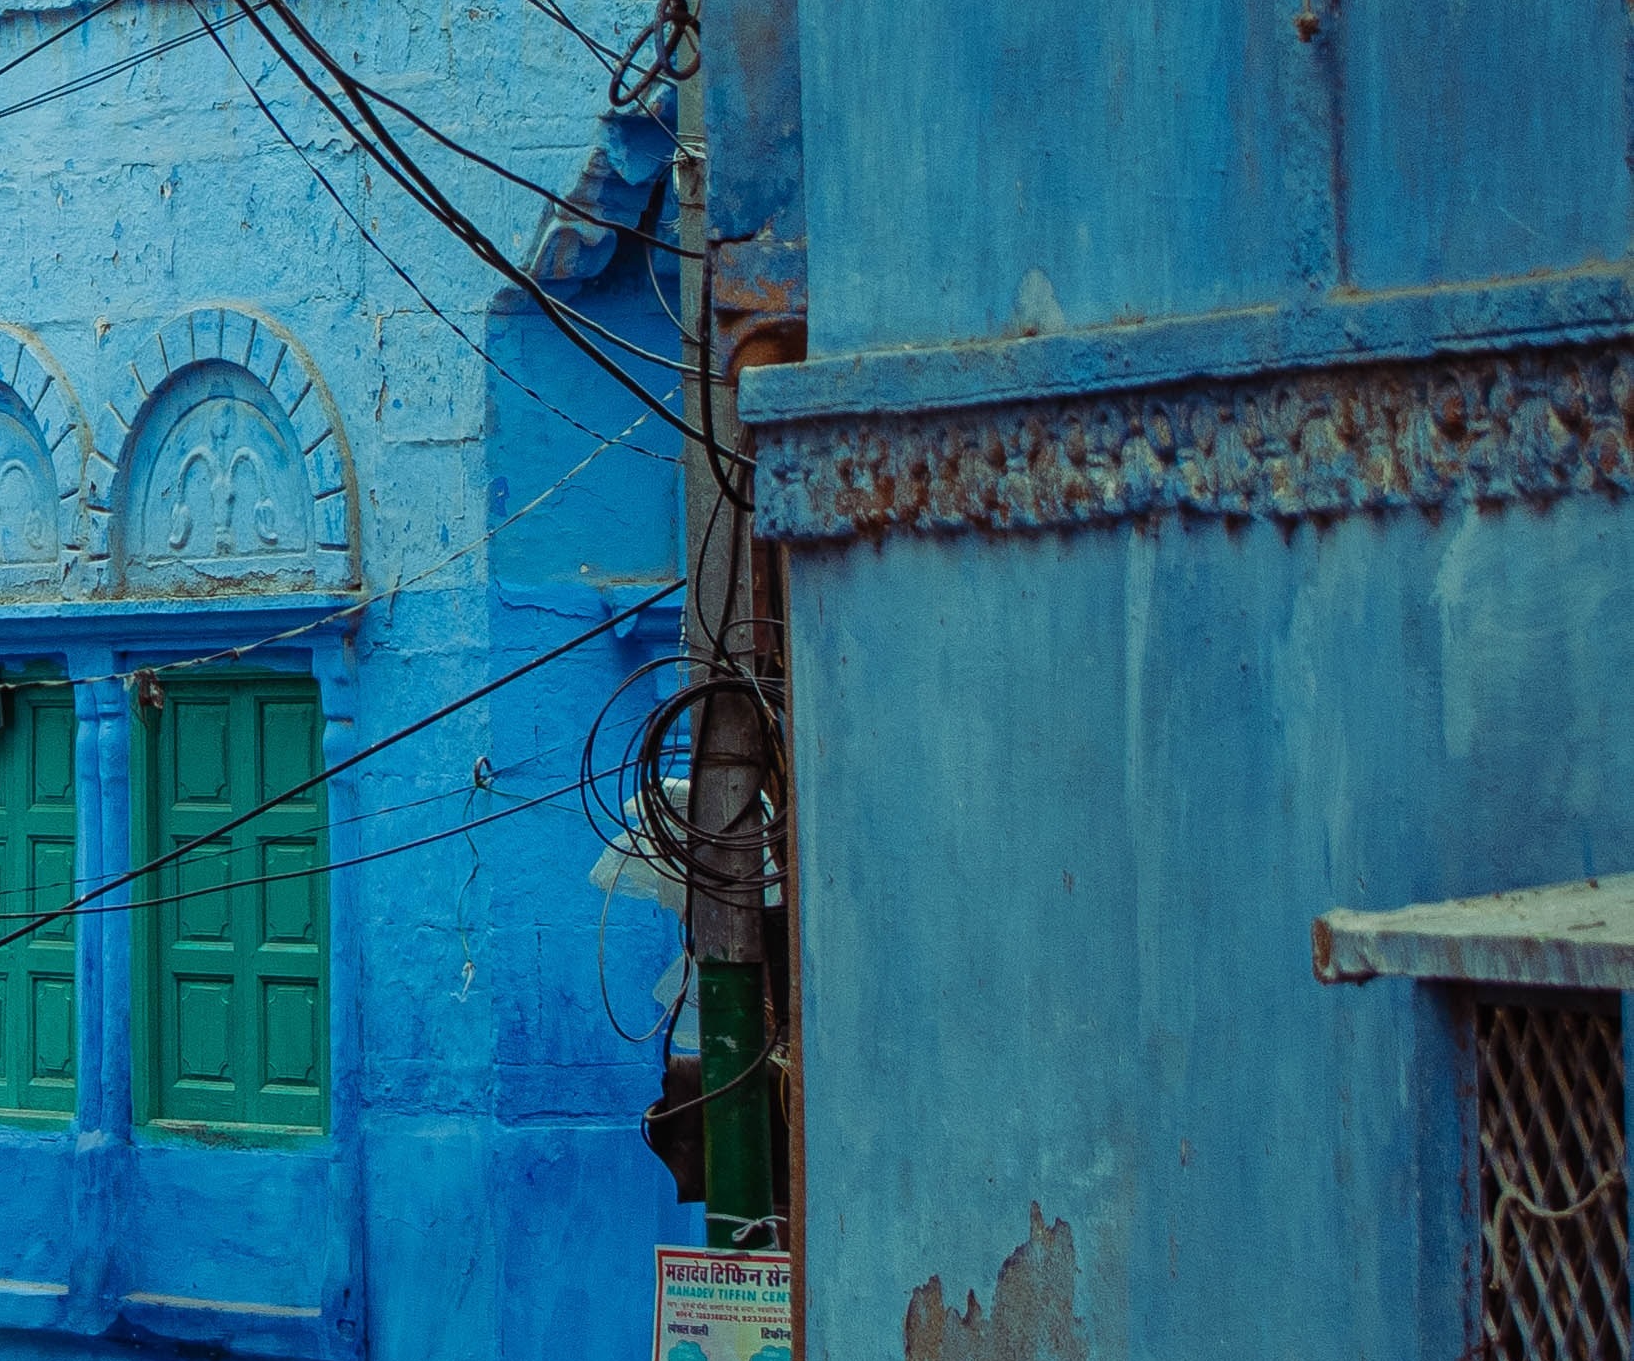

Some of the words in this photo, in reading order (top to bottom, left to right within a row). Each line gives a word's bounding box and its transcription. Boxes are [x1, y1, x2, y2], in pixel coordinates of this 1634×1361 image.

[665, 1260, 708, 1284] महादेव
[710, 1262, 762, 1286] टिफिन
[667, 1285, 715, 1299] MAHADEV
[718, 1289, 756, 1302] TIFFIN
[761, 1291, 790, 1304] CENT
